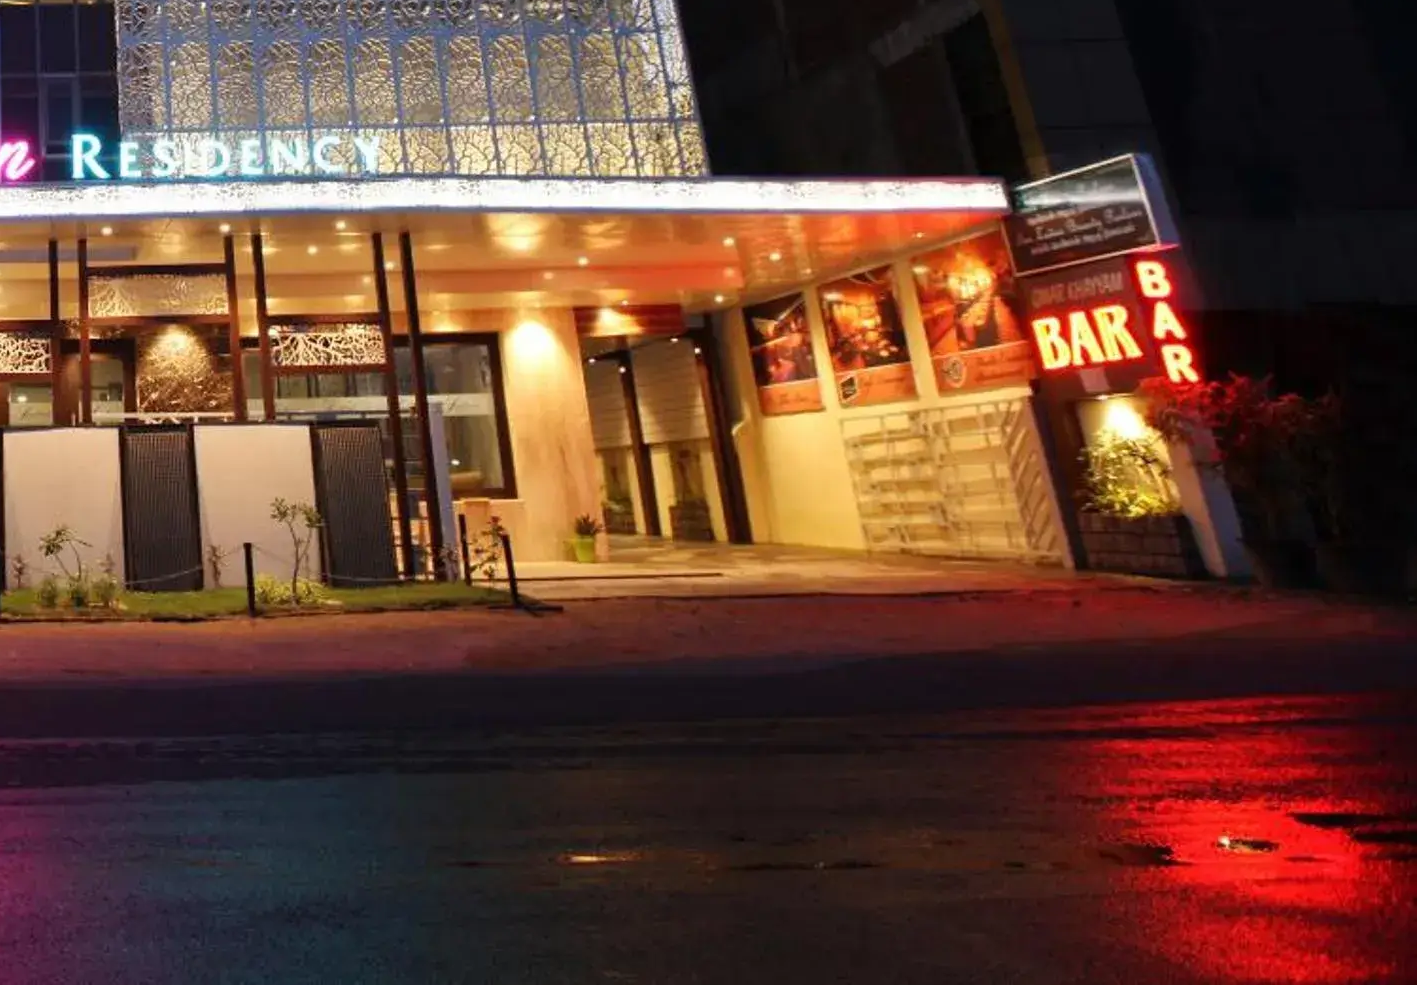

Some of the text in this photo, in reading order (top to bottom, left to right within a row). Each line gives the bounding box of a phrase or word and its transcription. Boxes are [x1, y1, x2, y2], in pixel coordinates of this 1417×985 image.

[70, 132, 382, 180] RESIDENCY
[1031, 304, 1145, 370] BAR
[1135, 260, 1200, 384] BAR
